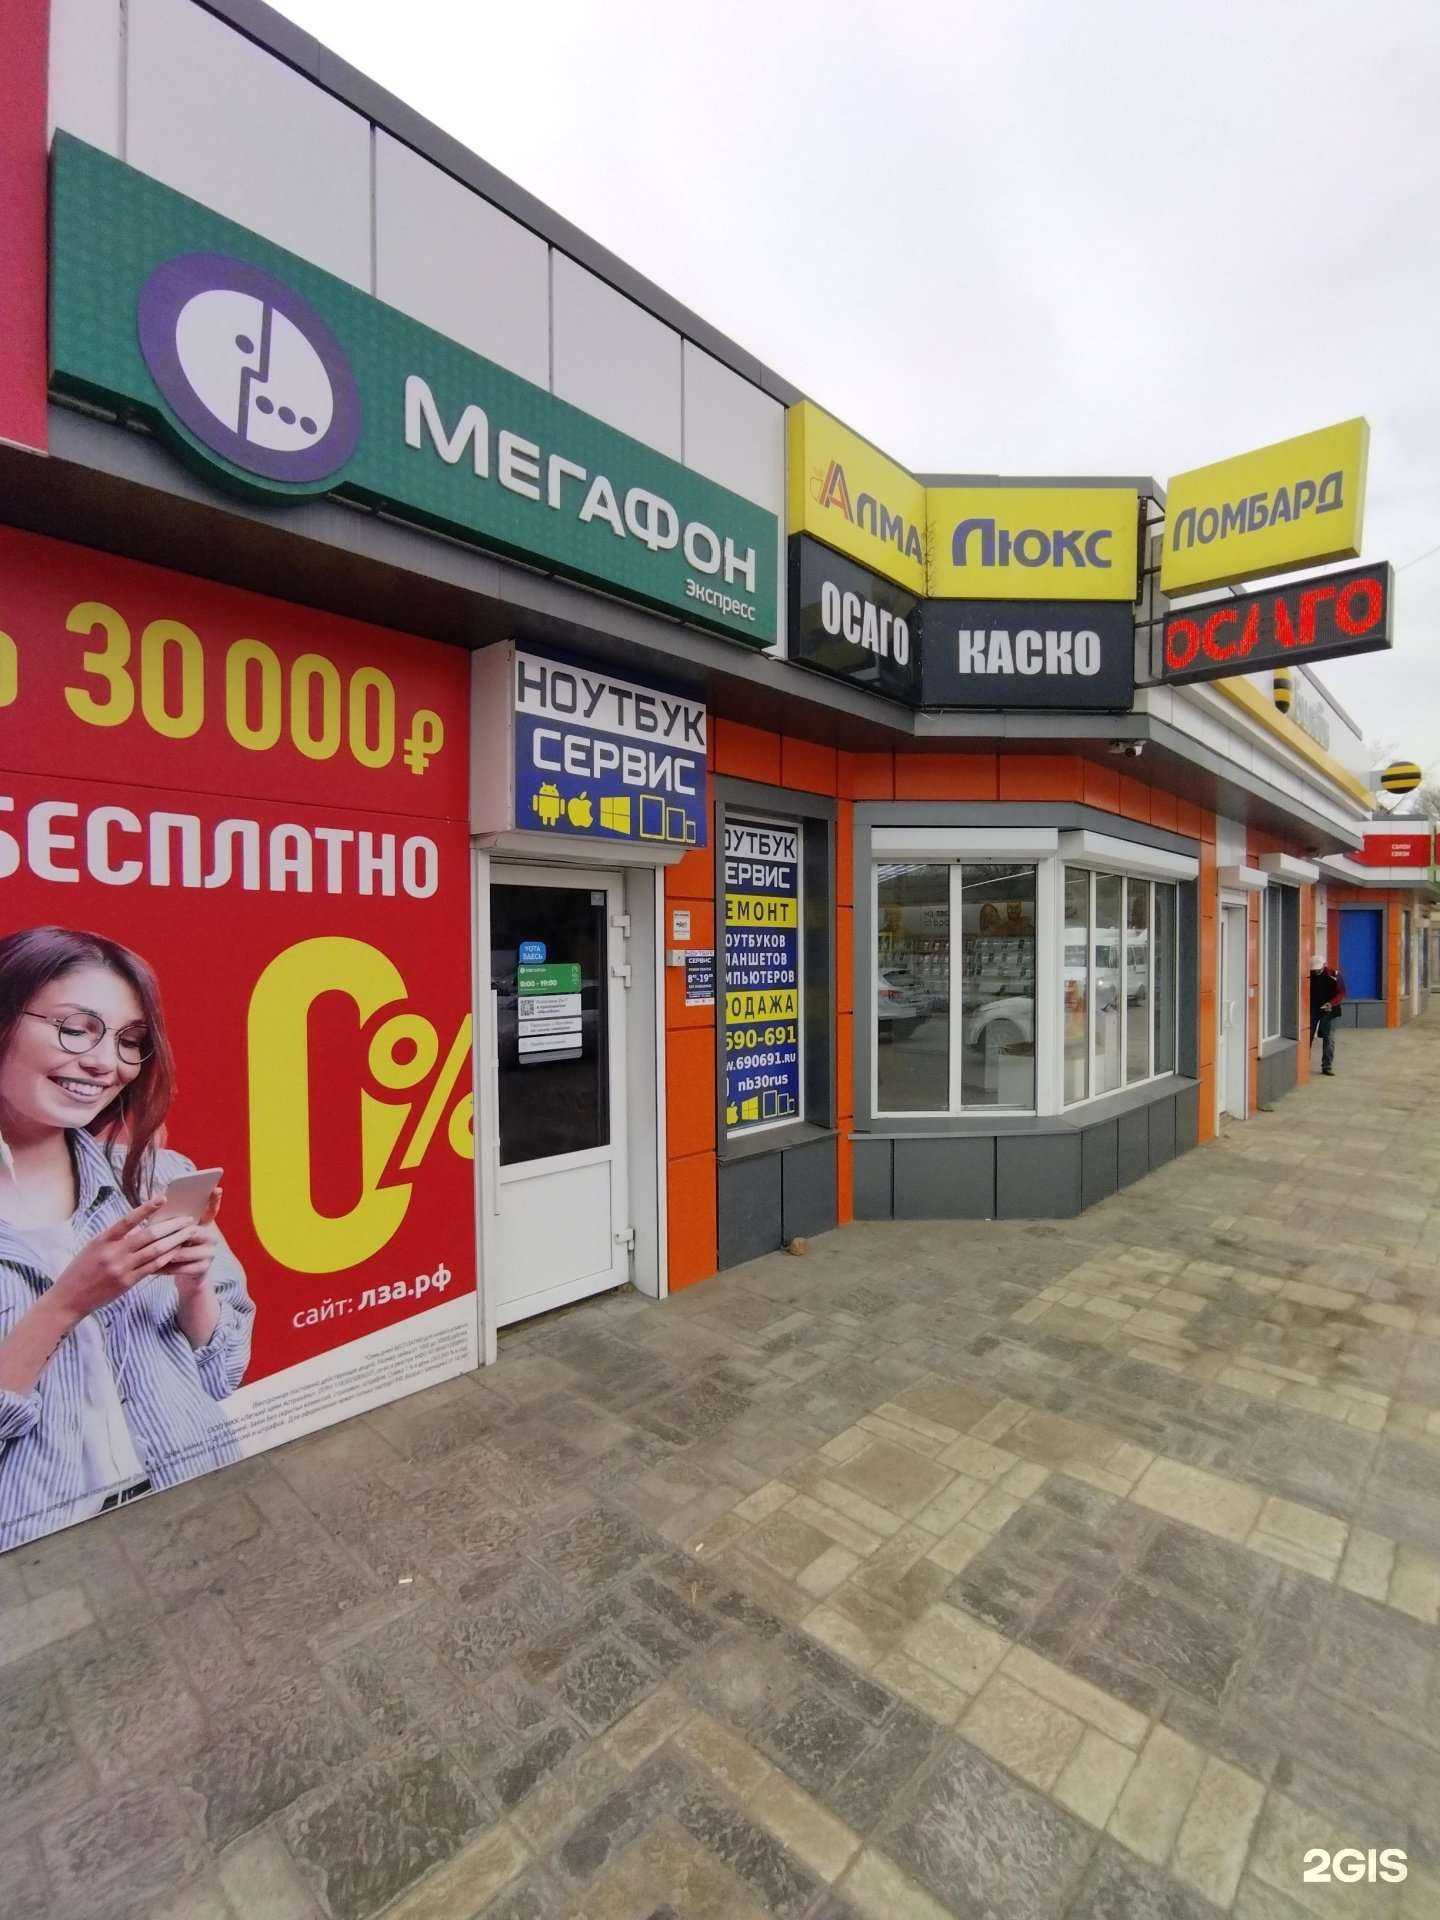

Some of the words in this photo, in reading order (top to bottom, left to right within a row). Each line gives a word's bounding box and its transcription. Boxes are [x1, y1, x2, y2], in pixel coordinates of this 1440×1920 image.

[952, 518, 1113, 568] ЛЮКС
[1173, 470, 1344, 551] ЛОМБАРД
[821, 580, 910, 666] ОСАГО
[958, 630, 1101, 676] КАСКО
[517, 660, 705, 746] НОУТБУК
[532, 727, 696, 796] СЕРВИС
[737, 1073, 789, 1092] nb30rus
[291, 1298, 354, 1330] сайт:
[357, 1262, 452, 1311] лза.рф
